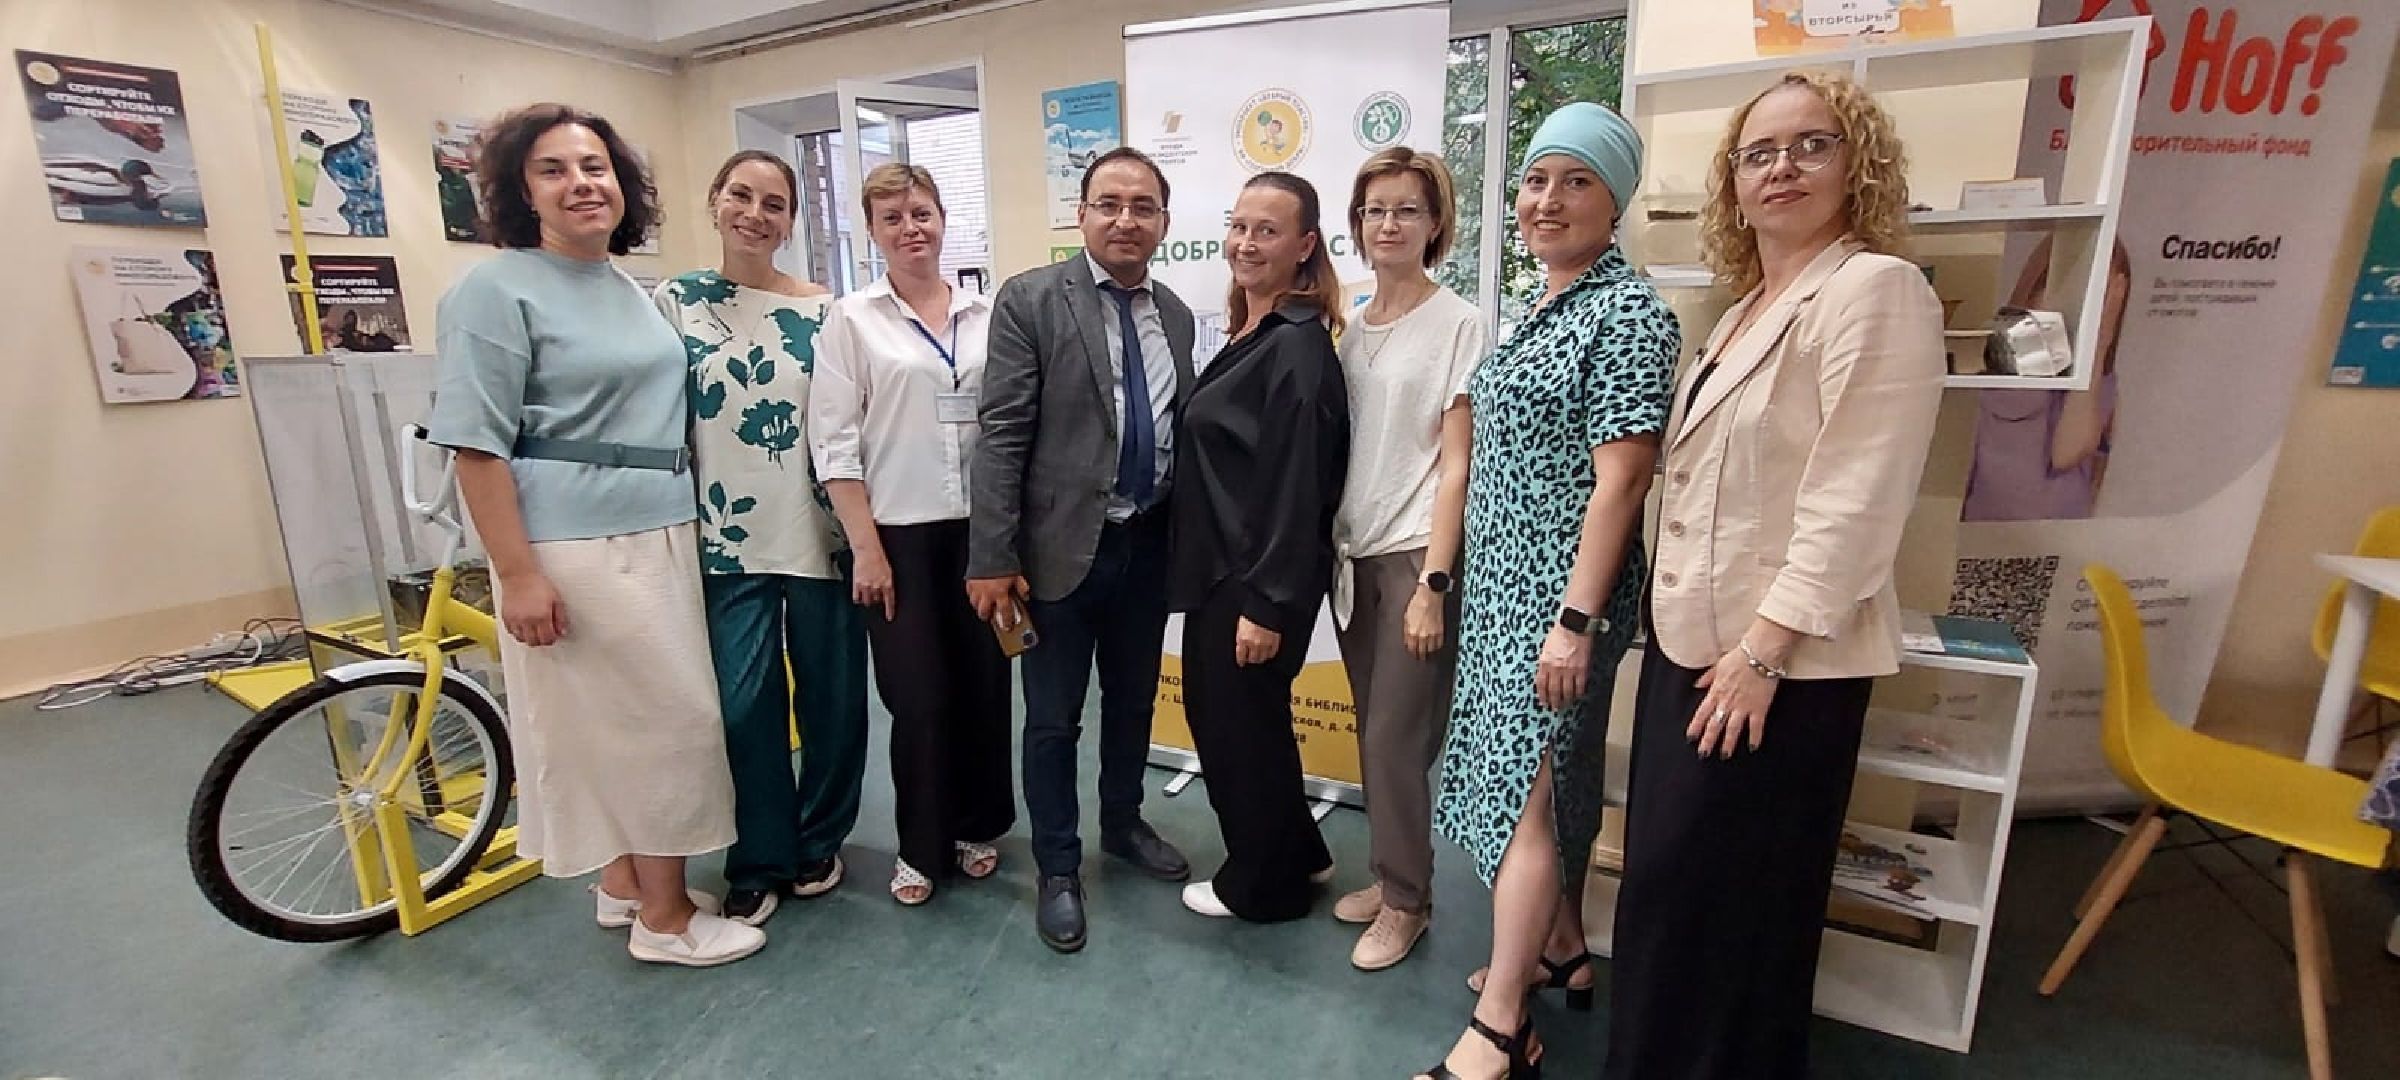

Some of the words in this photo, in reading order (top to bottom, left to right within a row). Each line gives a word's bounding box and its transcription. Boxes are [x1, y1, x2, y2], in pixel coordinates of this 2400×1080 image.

[1809, 12, 1893, 26] ВТОРСЫРЬЯ
[2264, 135, 2312, 159] фонд
[2162, 234, 2282, 260] Спасибо!
[1306, 697, 1357, 714] БИБЛИО
